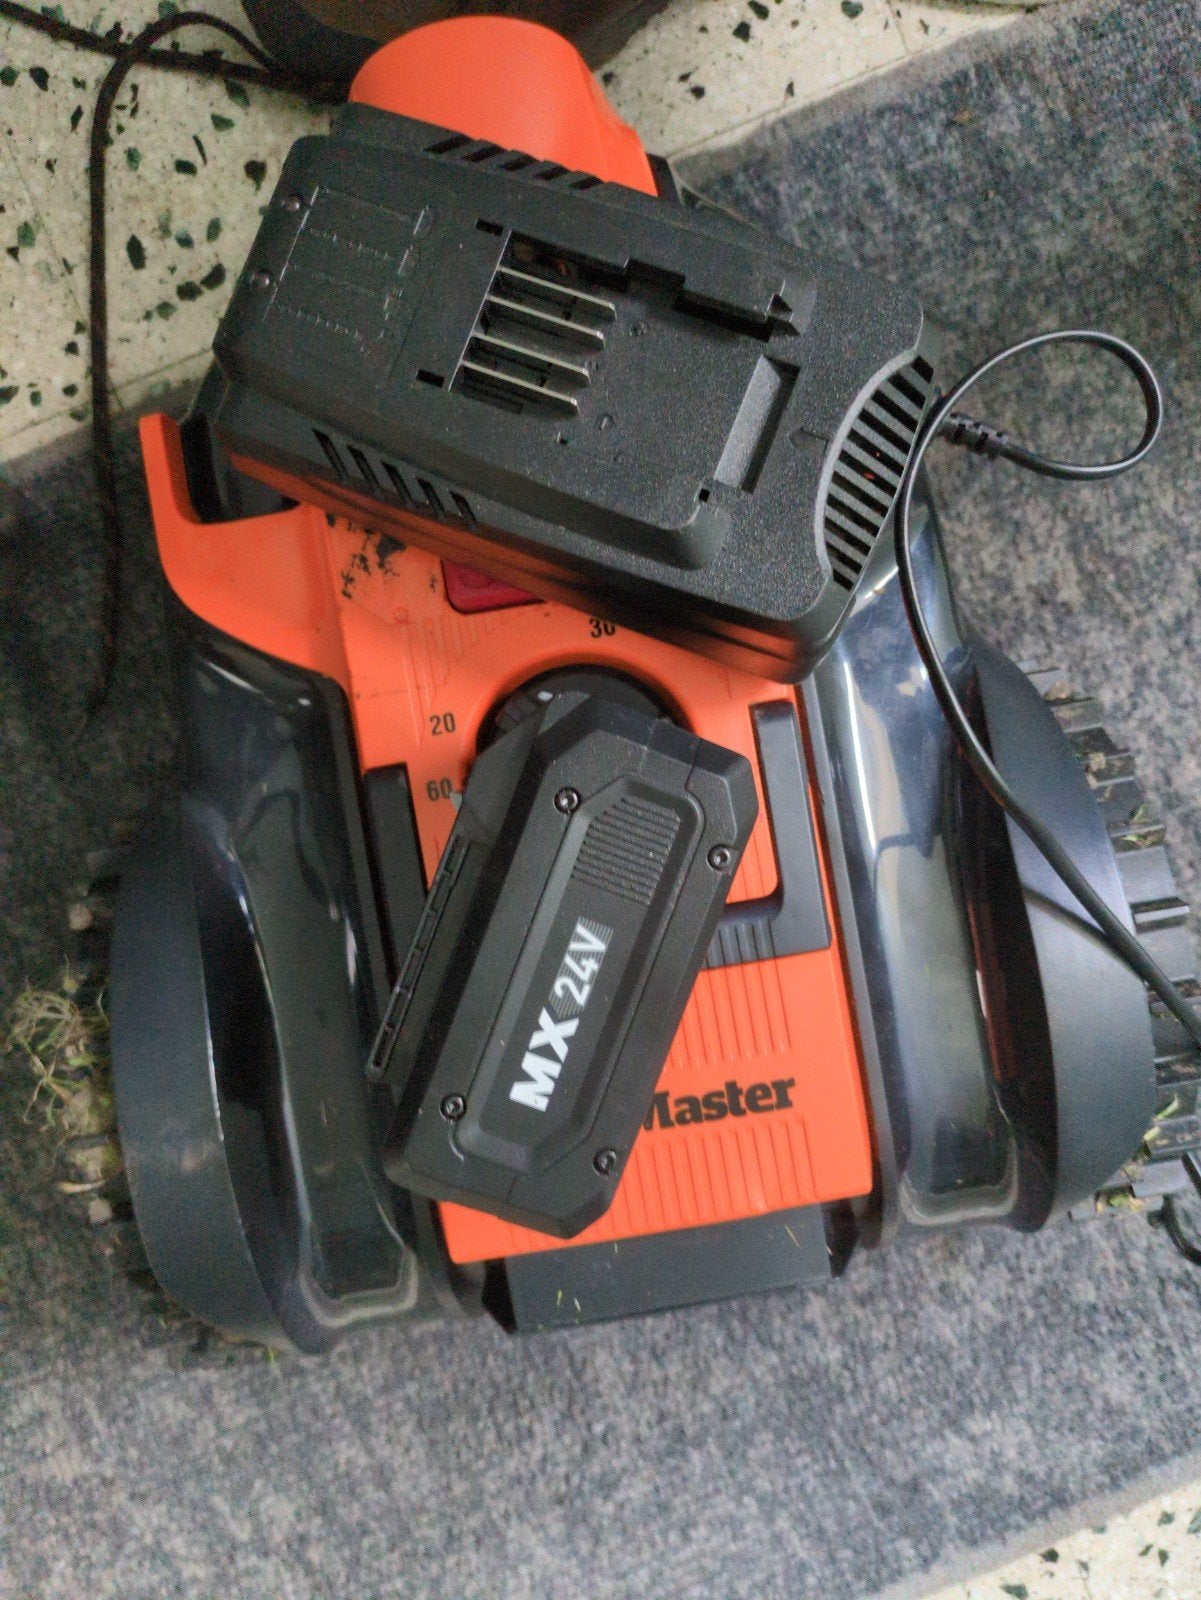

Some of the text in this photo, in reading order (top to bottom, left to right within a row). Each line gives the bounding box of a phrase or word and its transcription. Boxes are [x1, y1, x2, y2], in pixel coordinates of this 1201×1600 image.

[589, 617, 616, 638] 30
[429, 713, 456, 735] 20
[426, 777, 452, 801] 60
[509, 923, 607, 1112] MX 24V
